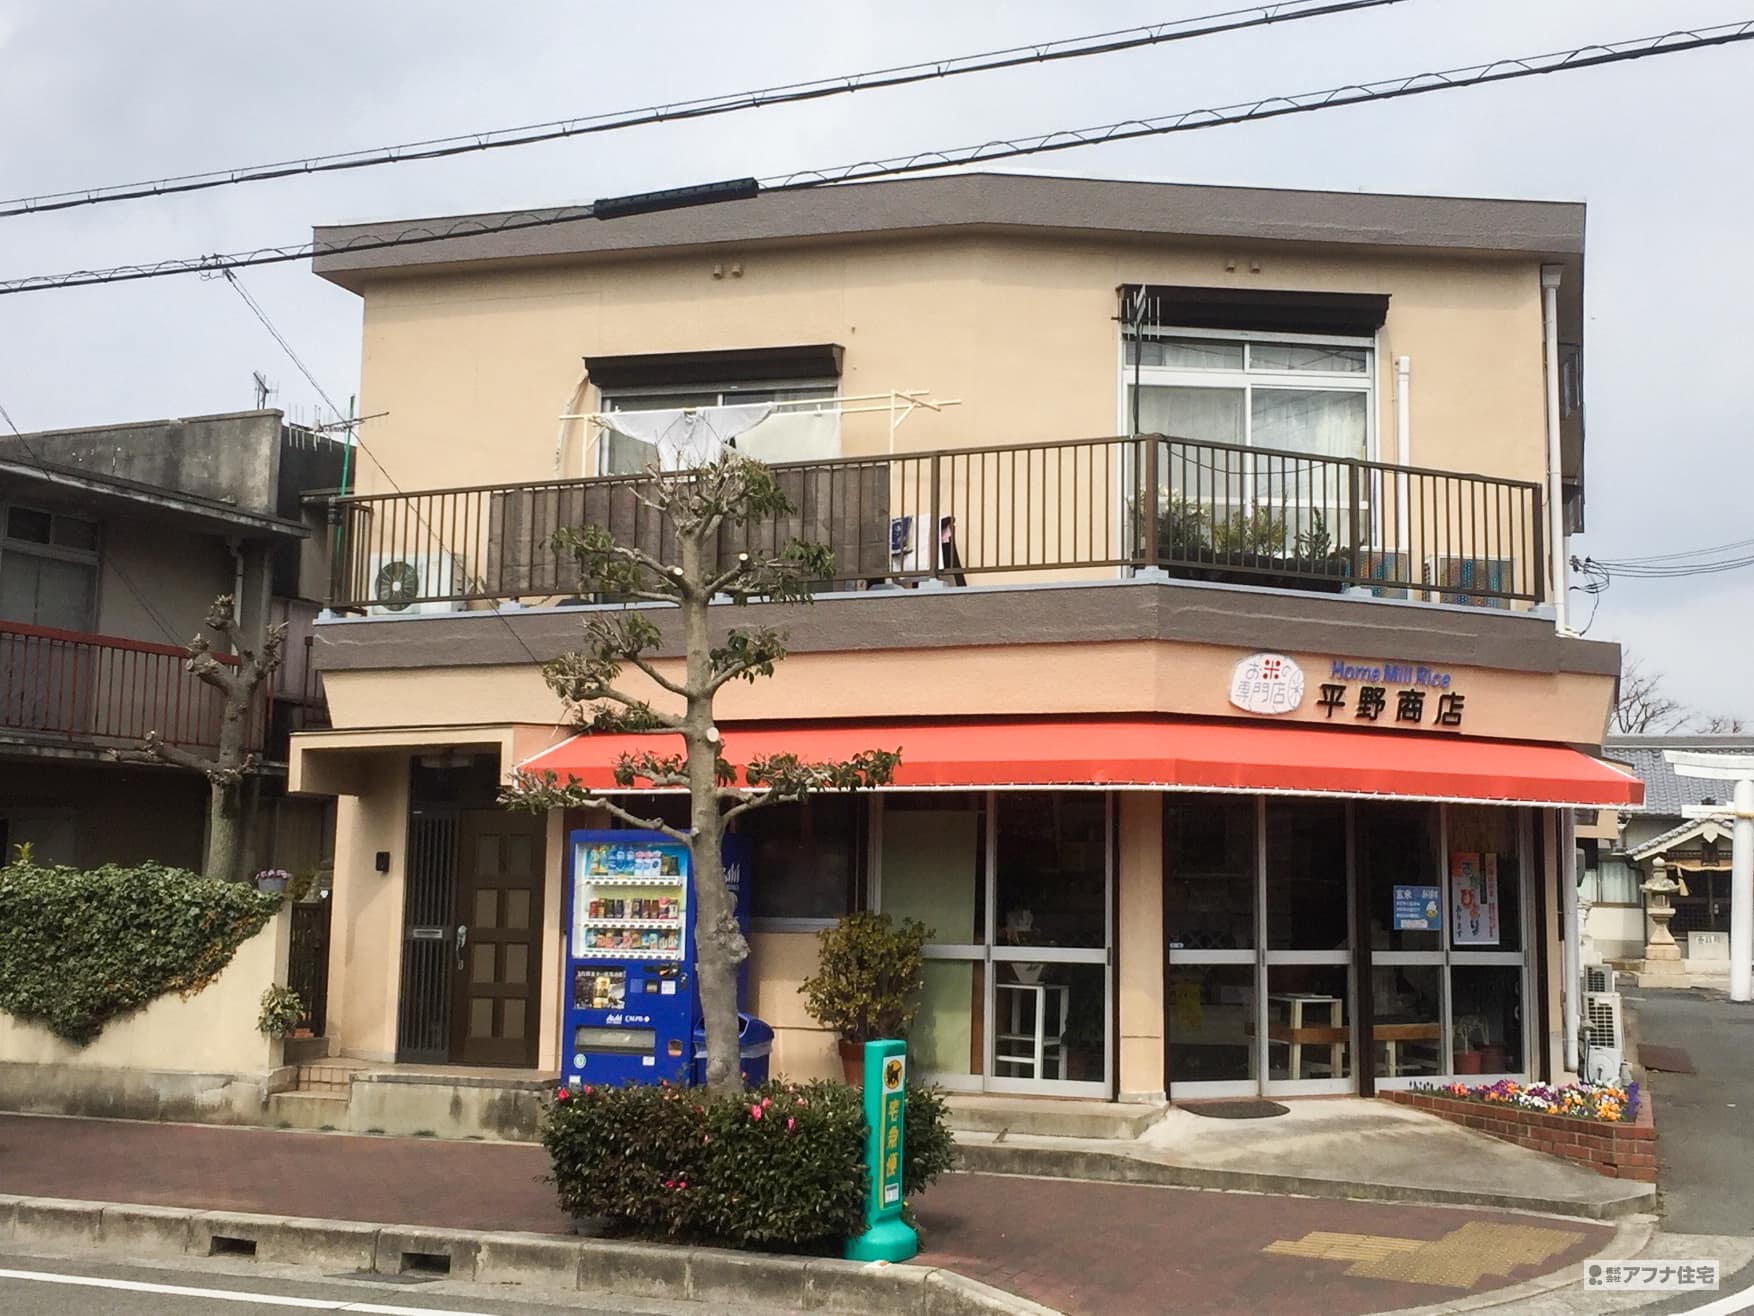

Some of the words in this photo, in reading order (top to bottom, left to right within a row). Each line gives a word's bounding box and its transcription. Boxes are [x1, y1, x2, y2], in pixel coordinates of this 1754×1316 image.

[1245, 658, 1292, 680] お米の
[1331, 660, 1380, 682] Home
[1383, 664, 1412, 685] Mill
[1415, 667, 1451, 689] Rice
[1317, 683, 1465, 726] 平野商店
[887, 1099, 899, 1177] 宅急便
